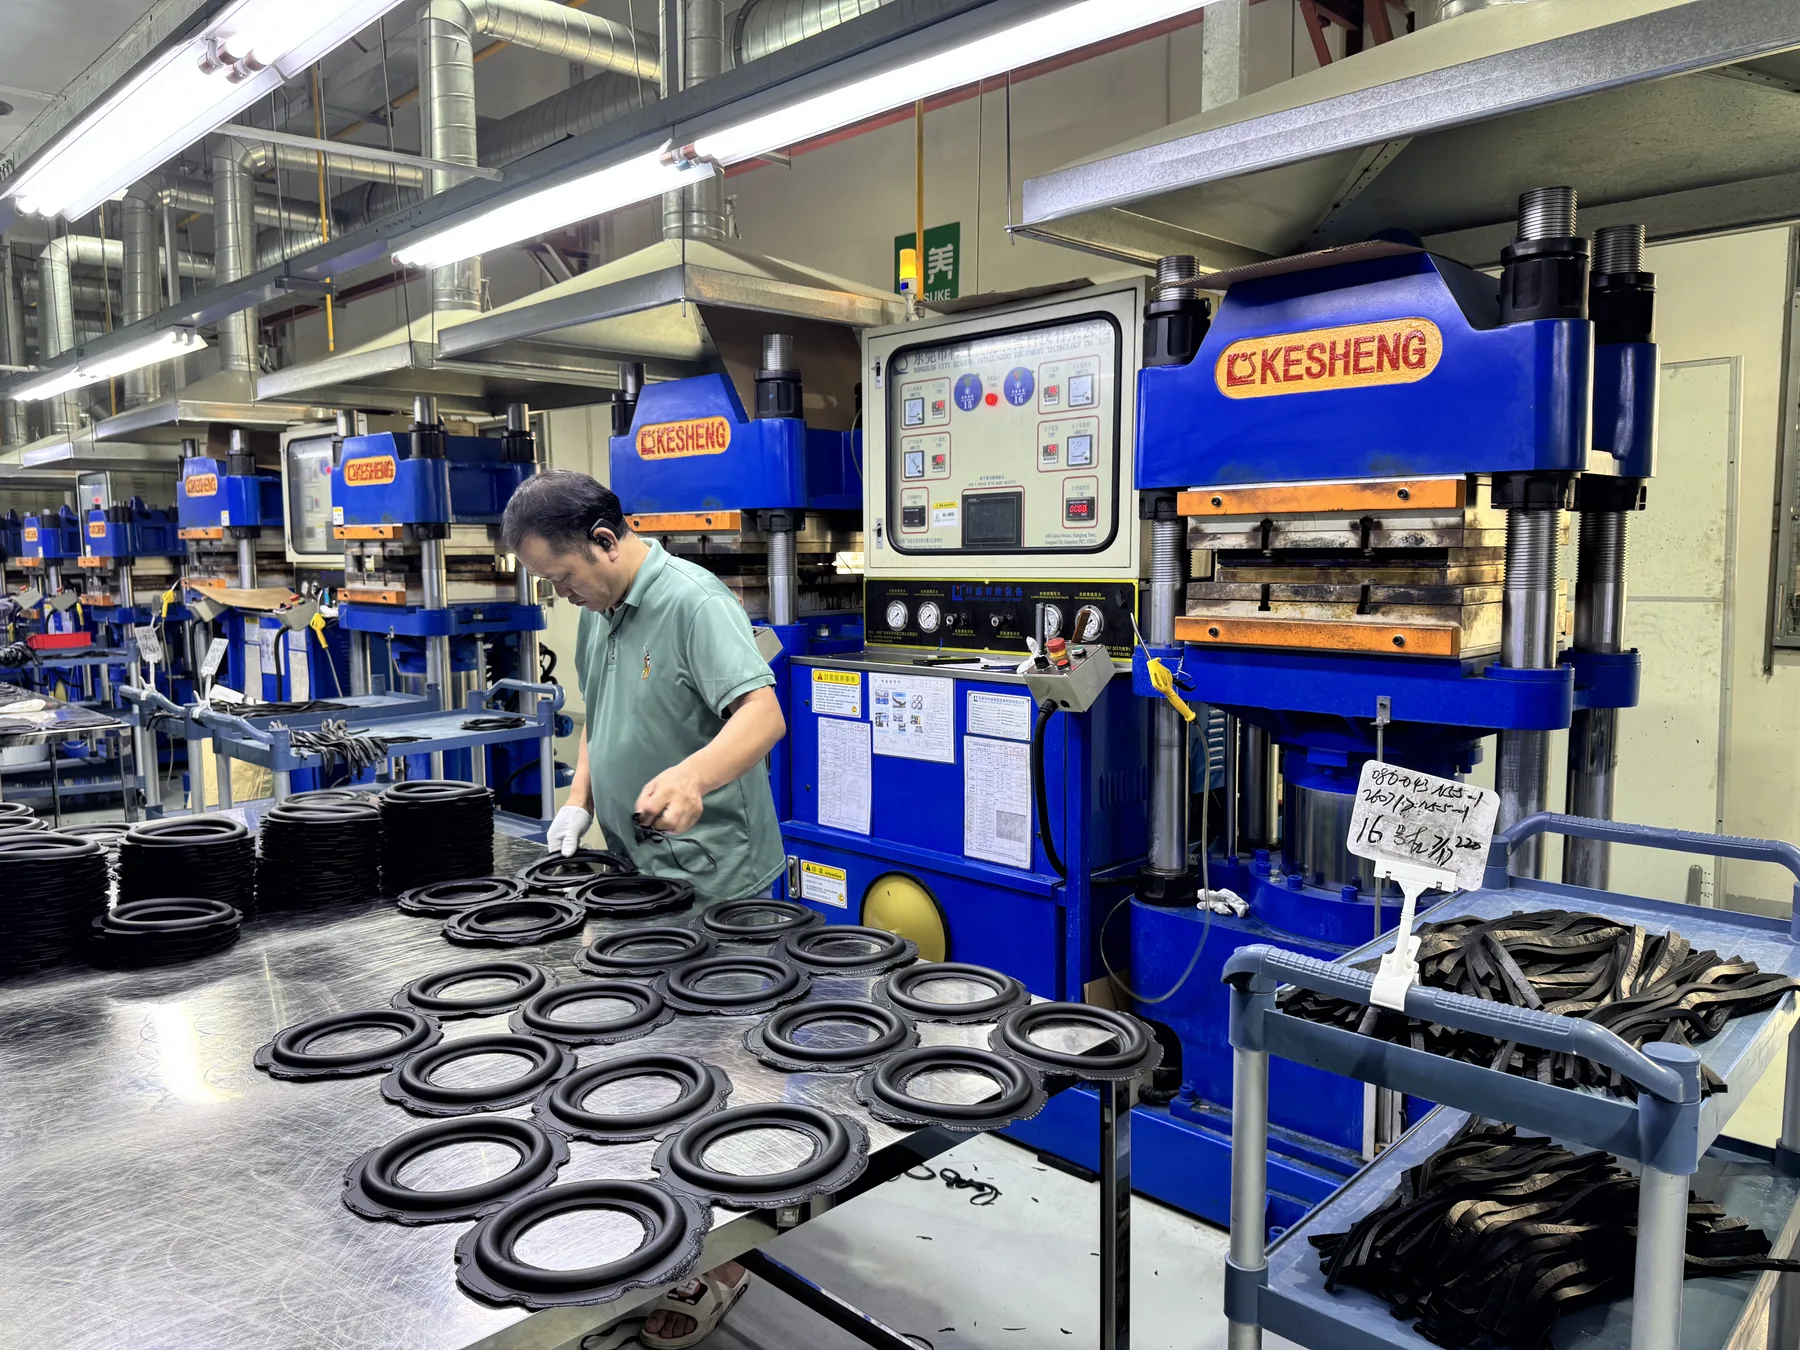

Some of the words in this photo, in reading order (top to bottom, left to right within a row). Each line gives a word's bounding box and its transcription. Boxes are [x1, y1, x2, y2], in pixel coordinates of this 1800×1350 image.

[938, 361, 950, 370] CITY
[1260, 329, 1427, 385] KESHENG
[963, 401, 972, 410] 15
[1014, 395, 1024, 404] 16
[656, 420, 726, 454] KESHENG
[355, 460, 394, 481] KESHENG
[1356, 814, 1384, 843] 16
